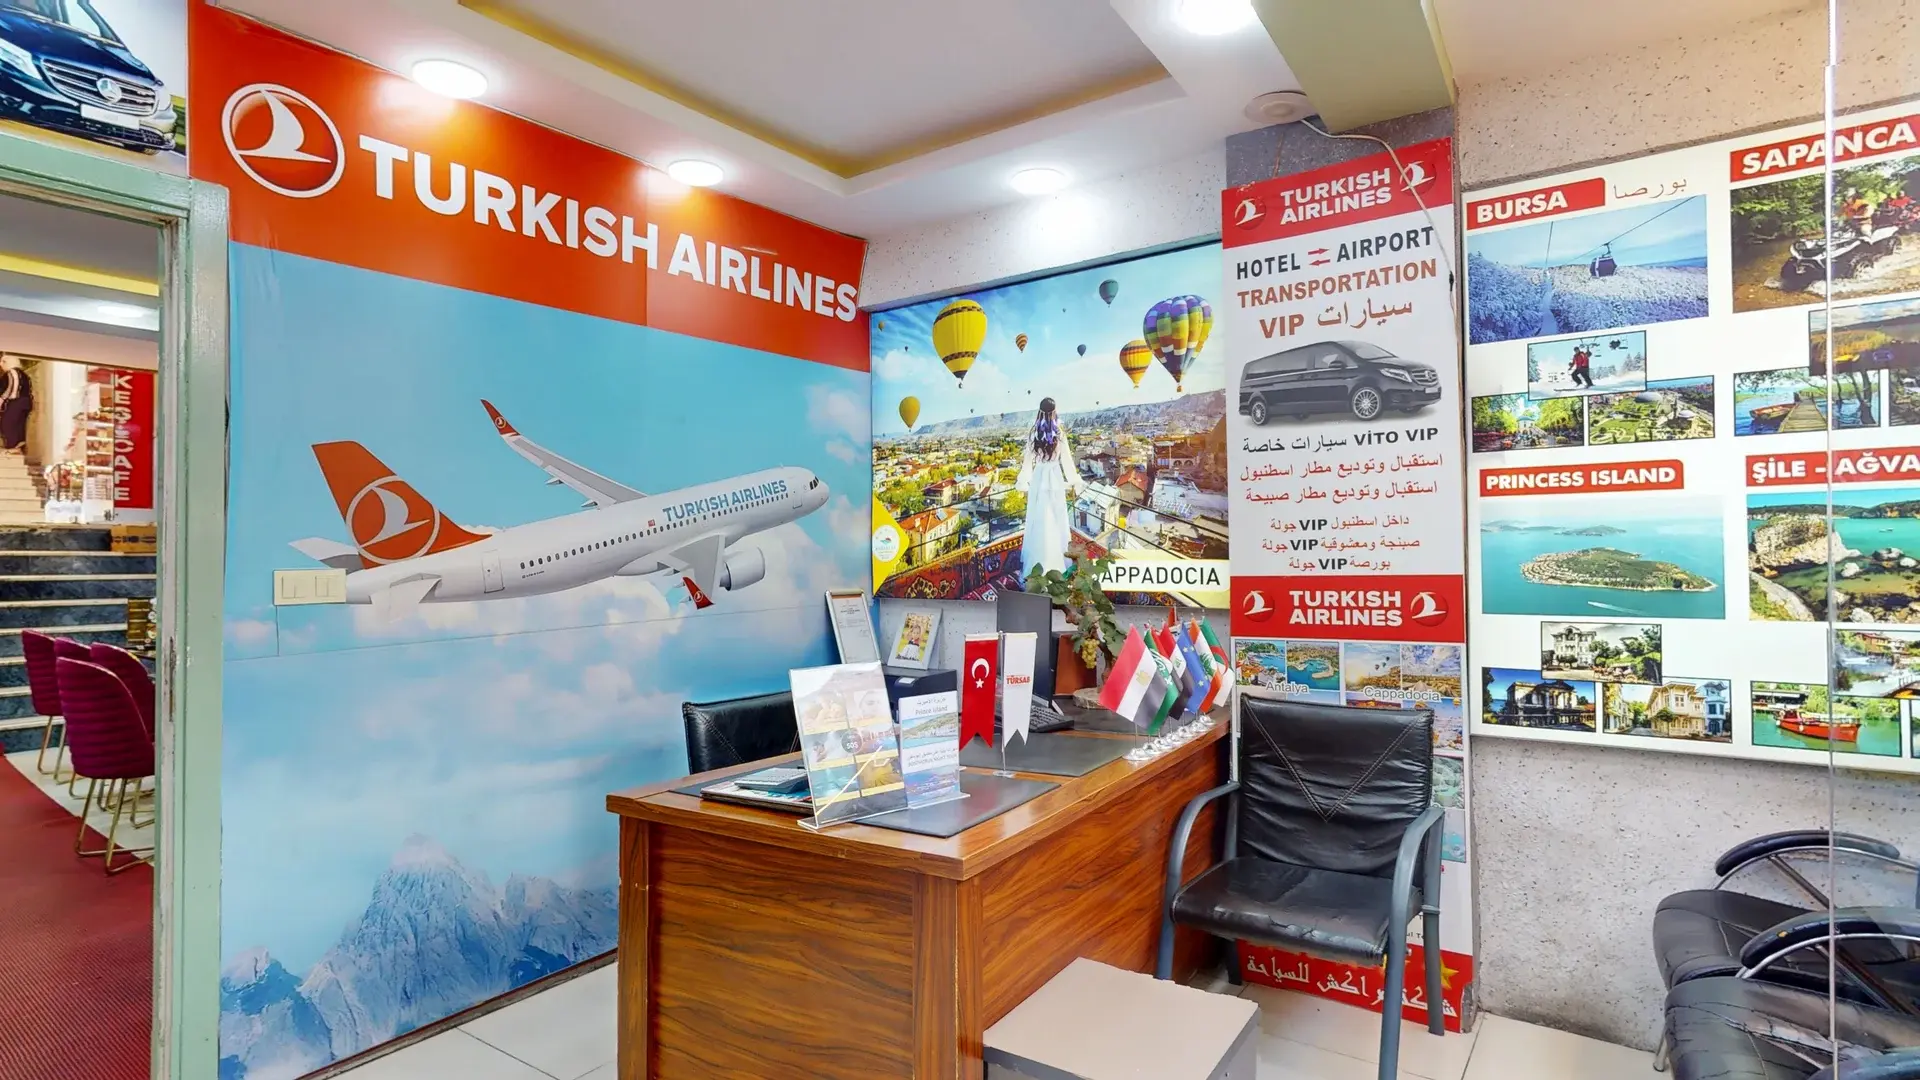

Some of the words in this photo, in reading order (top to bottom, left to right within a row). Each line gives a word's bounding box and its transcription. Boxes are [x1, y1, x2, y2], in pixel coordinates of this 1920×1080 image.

[1742, 122, 1917, 174] SAPANCA
[1280, 168, 1391, 207] TURKISH
[1280, 187, 1392, 225] AIRLINES
[1476, 190, 1568, 223] BURSA
[359, 134, 658, 270] TURKISH
[667, 233, 858, 323] AIRLINES
[1236, 253, 1300, 280] HOTEL
[1337, 226, 1434, 262] AIRPORT
[1237, 258, 1437, 308] TRANSPORTATION
[1317, 298, 1412, 329] سيارات
[1259, 313, 1304, 339] VIP
[1405, 427, 1439, 441] VIP
[1243, 438, 1285, 453] خاصة
[1291, 435, 1347, 453] سيارات
[1300, 461, 1331, 478] مطار
[1752, 457, 1806, 483] ŞİLE
[1834, 452, 1920, 476] AĞVA
[1486, 471, 1584, 490] PRINCESS
[1591, 467, 1676, 485] ISLAND
[662, 493, 729, 521] TURKISH
[732, 480, 787, 505] AIRLINES
[1296, 487, 1326, 504] مطار
[1299, 519, 1328, 531] VIP
[1290, 539, 1318, 551] VIP
[1318, 558, 1348, 570] VIP
[1101, 566, 1221, 585] APPADOCIA
[1289, 590, 1401, 608] TURKISH
[1289, 609, 1402, 627] AIRLINES
[1266, 681, 1309, 694] Antalya
[1364, 686, 1440, 702] Cappadocia
